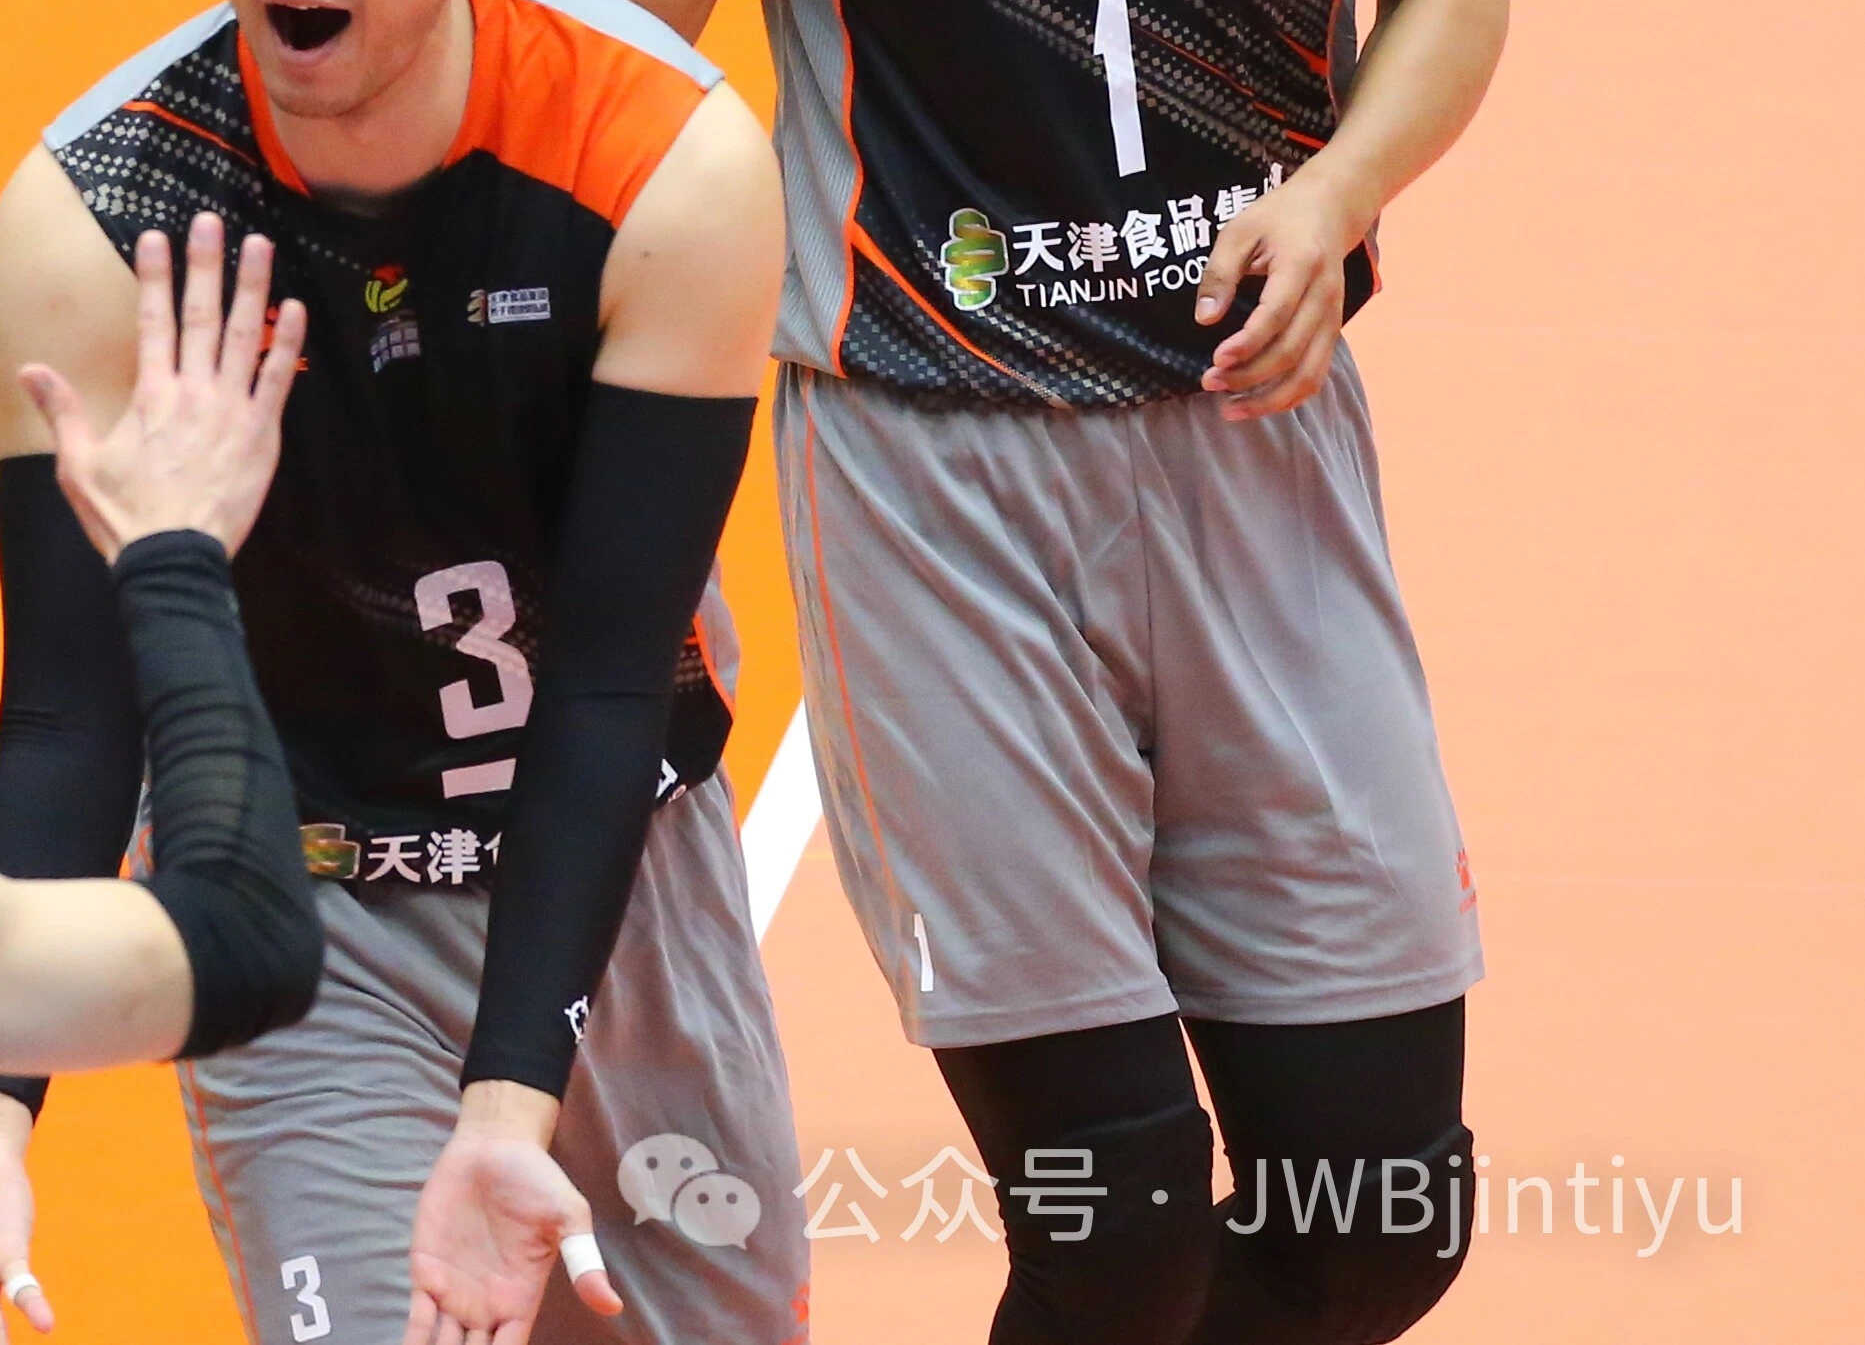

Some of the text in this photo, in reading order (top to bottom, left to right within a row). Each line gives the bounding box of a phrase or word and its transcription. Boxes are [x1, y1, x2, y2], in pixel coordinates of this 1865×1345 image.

[1016, 279, 1137, 308] TIANJIN
[414, 560, 534, 739] 3
[364, 828, 503, 885] 天津
[913, 912, 934, 992] 1
[280, 1255, 331, 1342] 3
